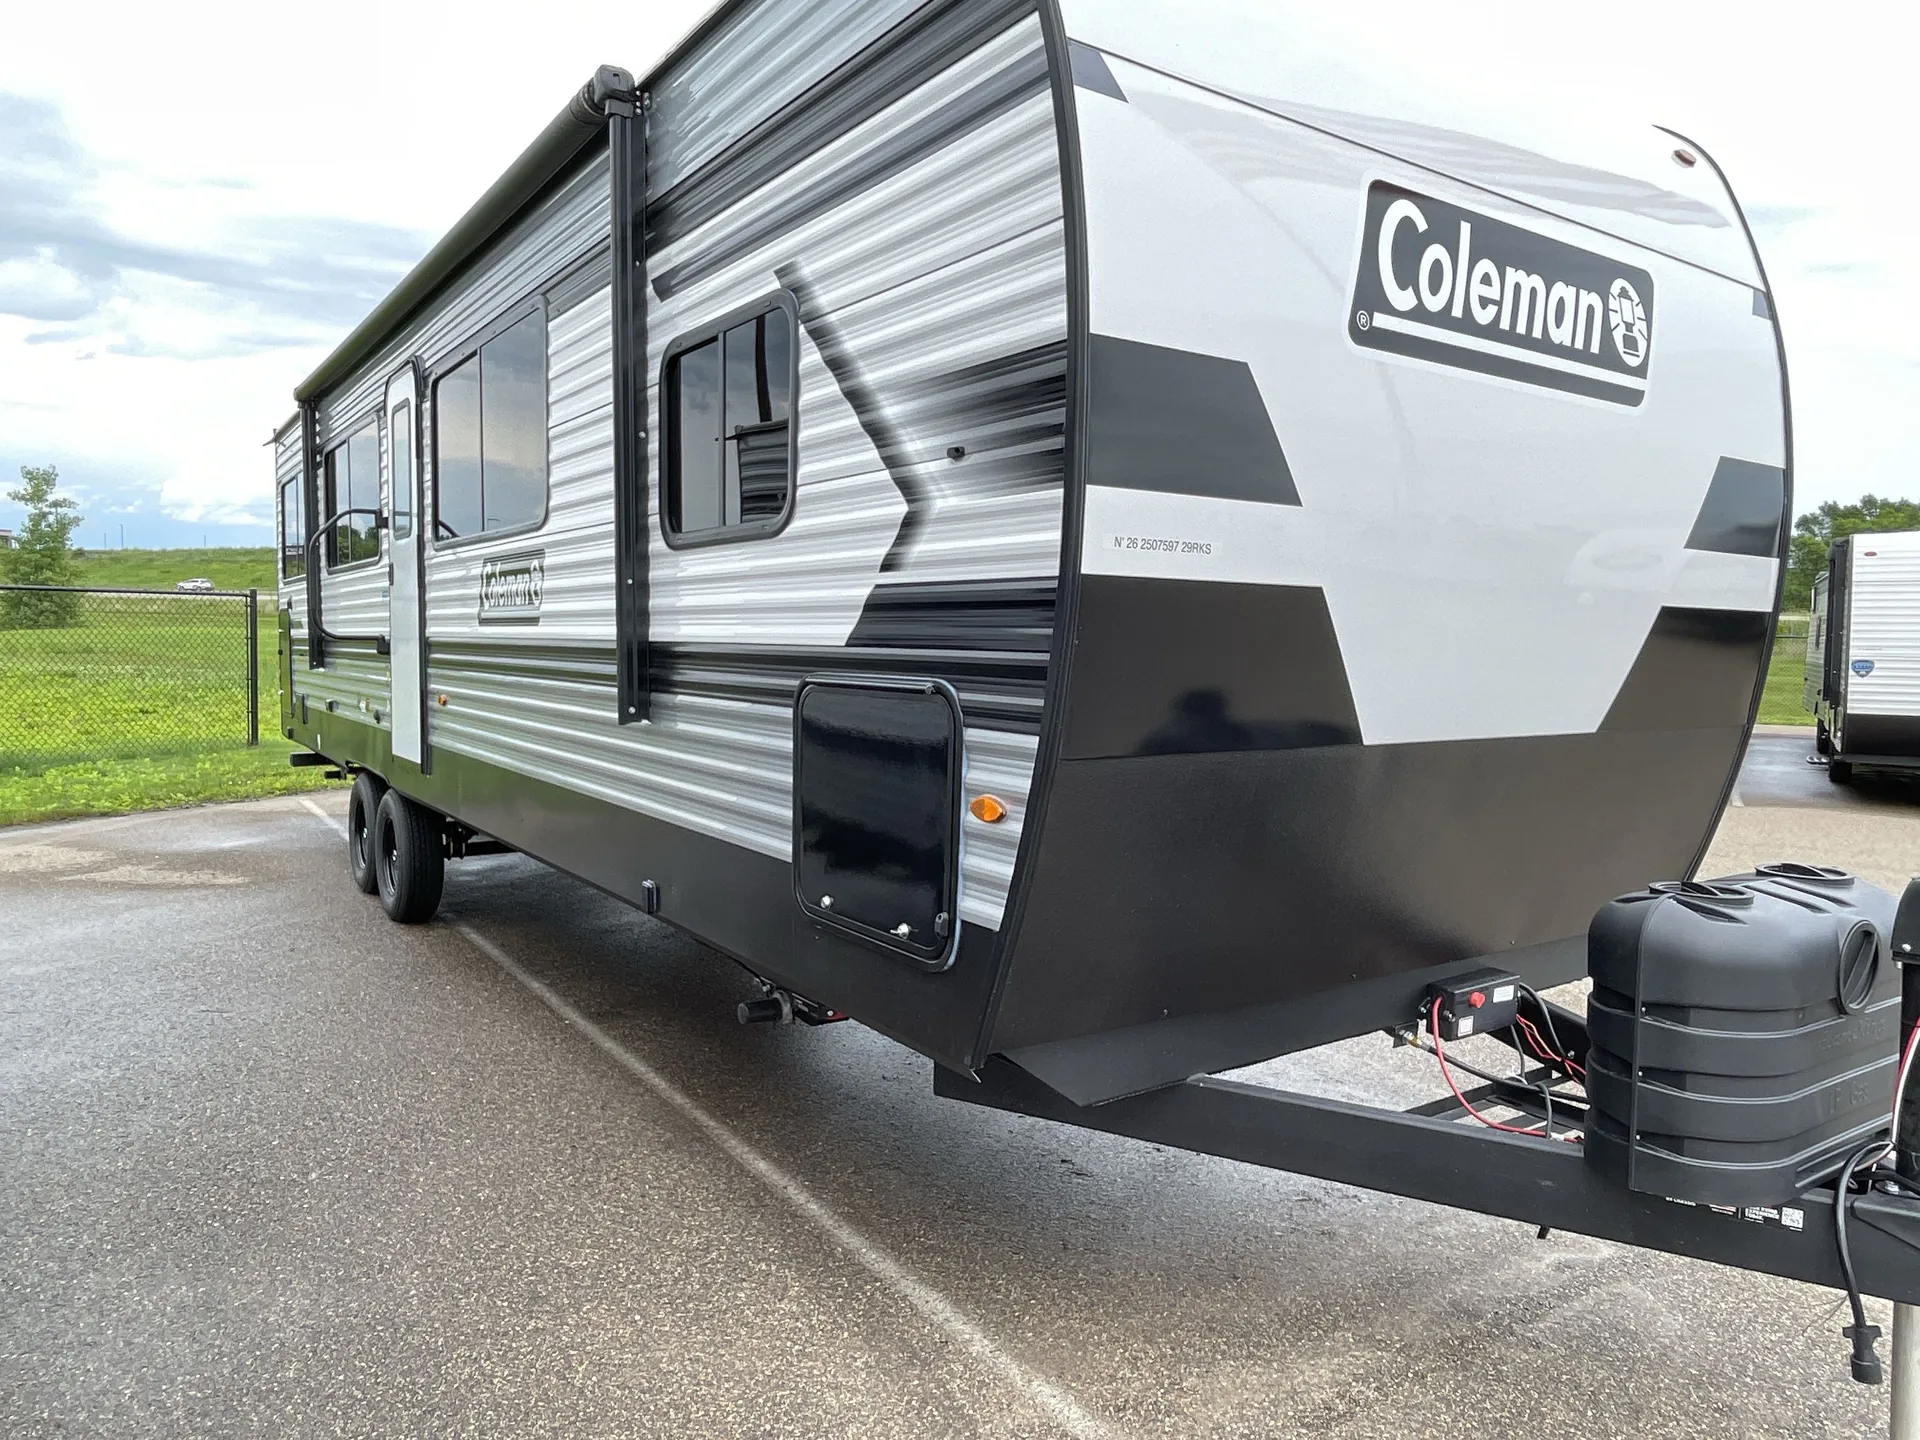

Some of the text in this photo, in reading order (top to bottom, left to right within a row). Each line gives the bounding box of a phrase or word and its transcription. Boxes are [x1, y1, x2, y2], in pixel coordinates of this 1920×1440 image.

[1378, 199, 1604, 354] Coleman
[1126, 537, 1139, 550] 26
[1140, 538, 1179, 552] 2507597
[1181, 541, 1212, 555] 29RKS
